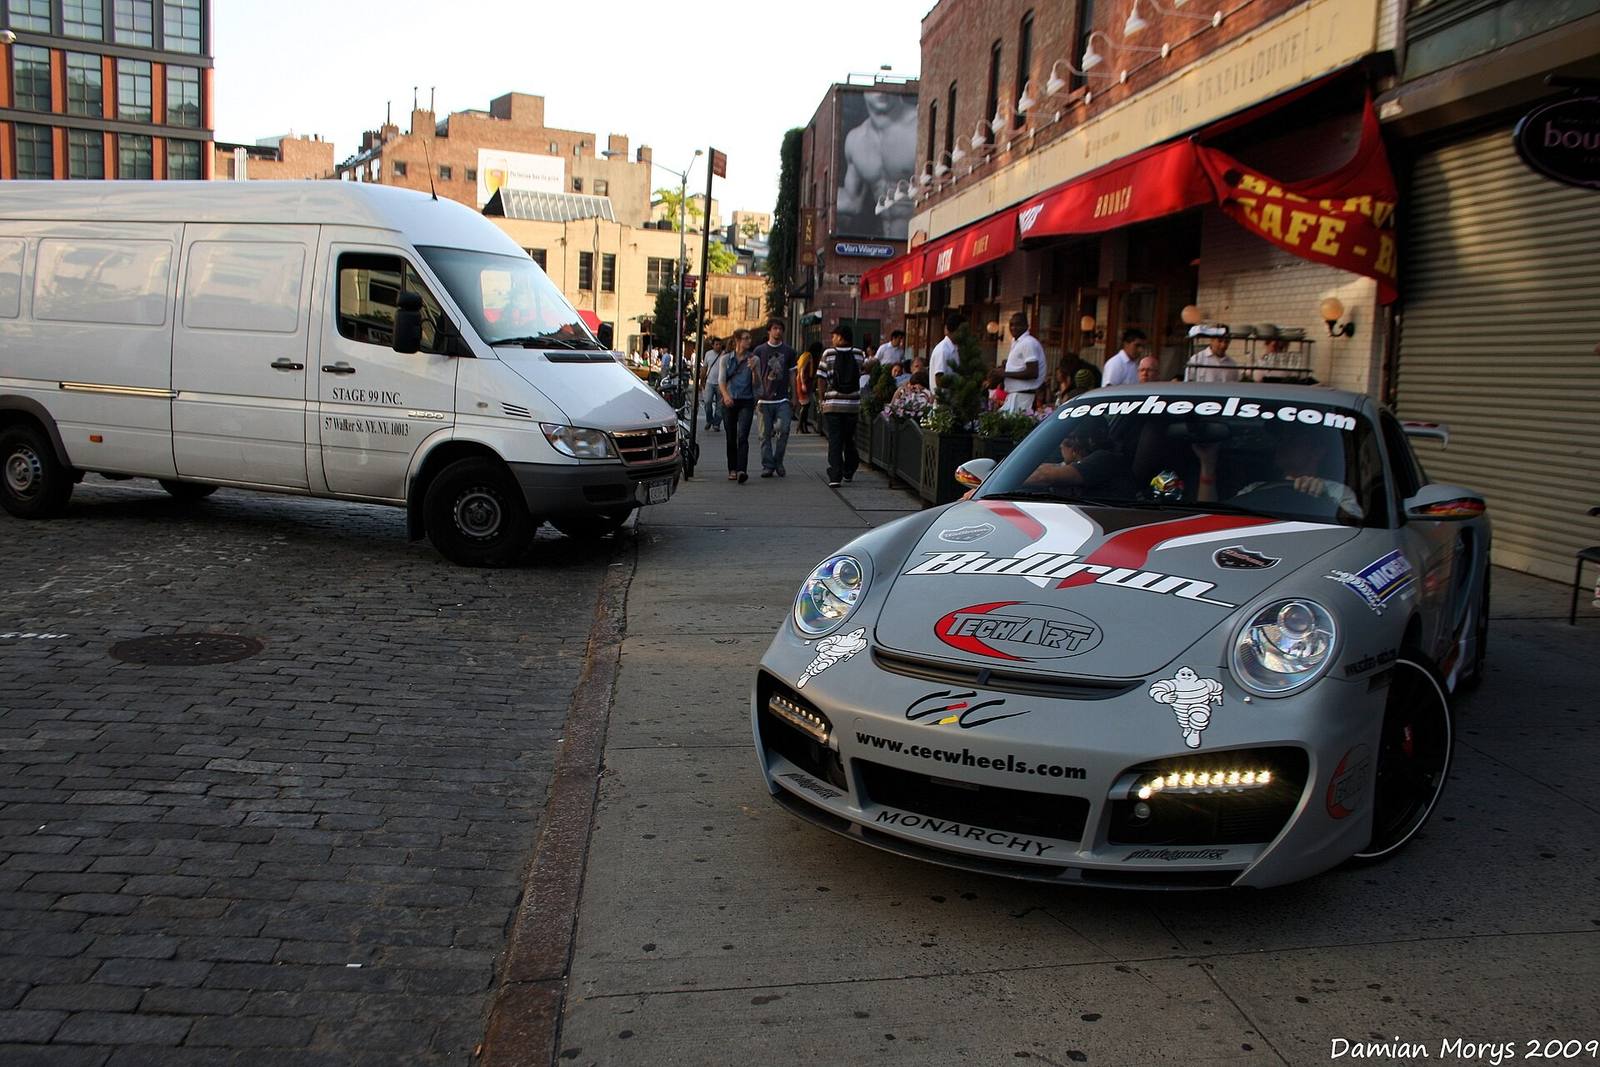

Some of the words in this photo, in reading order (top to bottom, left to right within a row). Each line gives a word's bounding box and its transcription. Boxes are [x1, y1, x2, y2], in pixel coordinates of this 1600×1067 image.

[843, 244, 858, 252] Van
[859, 244, 889, 256] Wagner
[332, 386, 366, 402] STAGE
[368, 390, 379, 402] 99
[381, 391, 403, 406] INC.
[1057, 395, 1357, 431] cecwheels.com
[324, 416, 333, 430] 57
[333, 417, 356, 432] Walker
[903, 551, 1240, 609] Bullrun
[1366, 556, 1412, 590] MICHE
[855, 730, 1088, 781] www.cecwheels.com
[875, 810, 1054, 858] MONARCHY
